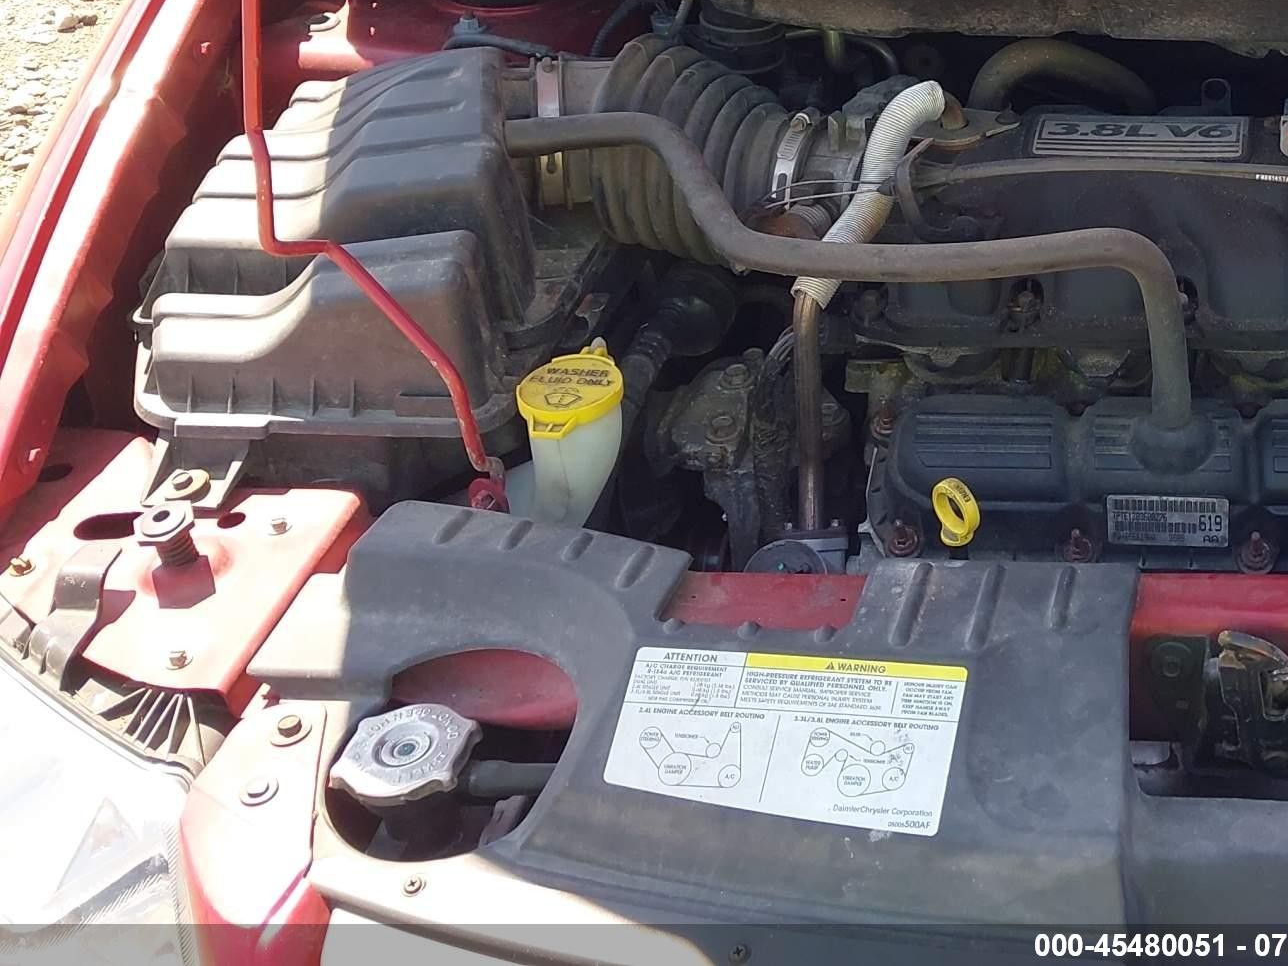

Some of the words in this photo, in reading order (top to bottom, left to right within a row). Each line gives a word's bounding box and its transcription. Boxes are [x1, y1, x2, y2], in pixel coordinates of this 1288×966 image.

[1047, 122, 1162, 138] 3.8L
[1165, 123, 1233, 139] V6
[547, 368, 610, 377] WASHER
[529, 376, 572, 384] FLUID
[577, 378, 615, 387] ONLY
[1199, 515, 1222, 532] 619
[663, 652, 718, 663] ATTENTION
[837, 662, 886, 674] WARNING
[744, 677, 778, 685] SERVICED
[790, 680, 826, 689] QUALIFIED
[827, 682, 866, 691] PERSONNEL
[746, 671, 798, 680] HIGH-PRESSURE
[799, 673, 846, 683] REFRIGERANT
[847, 677, 872, 685] SYSTEM
[679, 709, 719, 717] ACCESSORY
[735, 712, 765, 720] ROUTING
[794, 716, 824, 724] 3.3L/3.8L
[851, 720, 891, 728] ACCESSORY
[908, 723, 940, 731] ROUTING
[833, 804, 890, 815] DaimlerChrysler
[891, 808, 933, 817] Corporation
